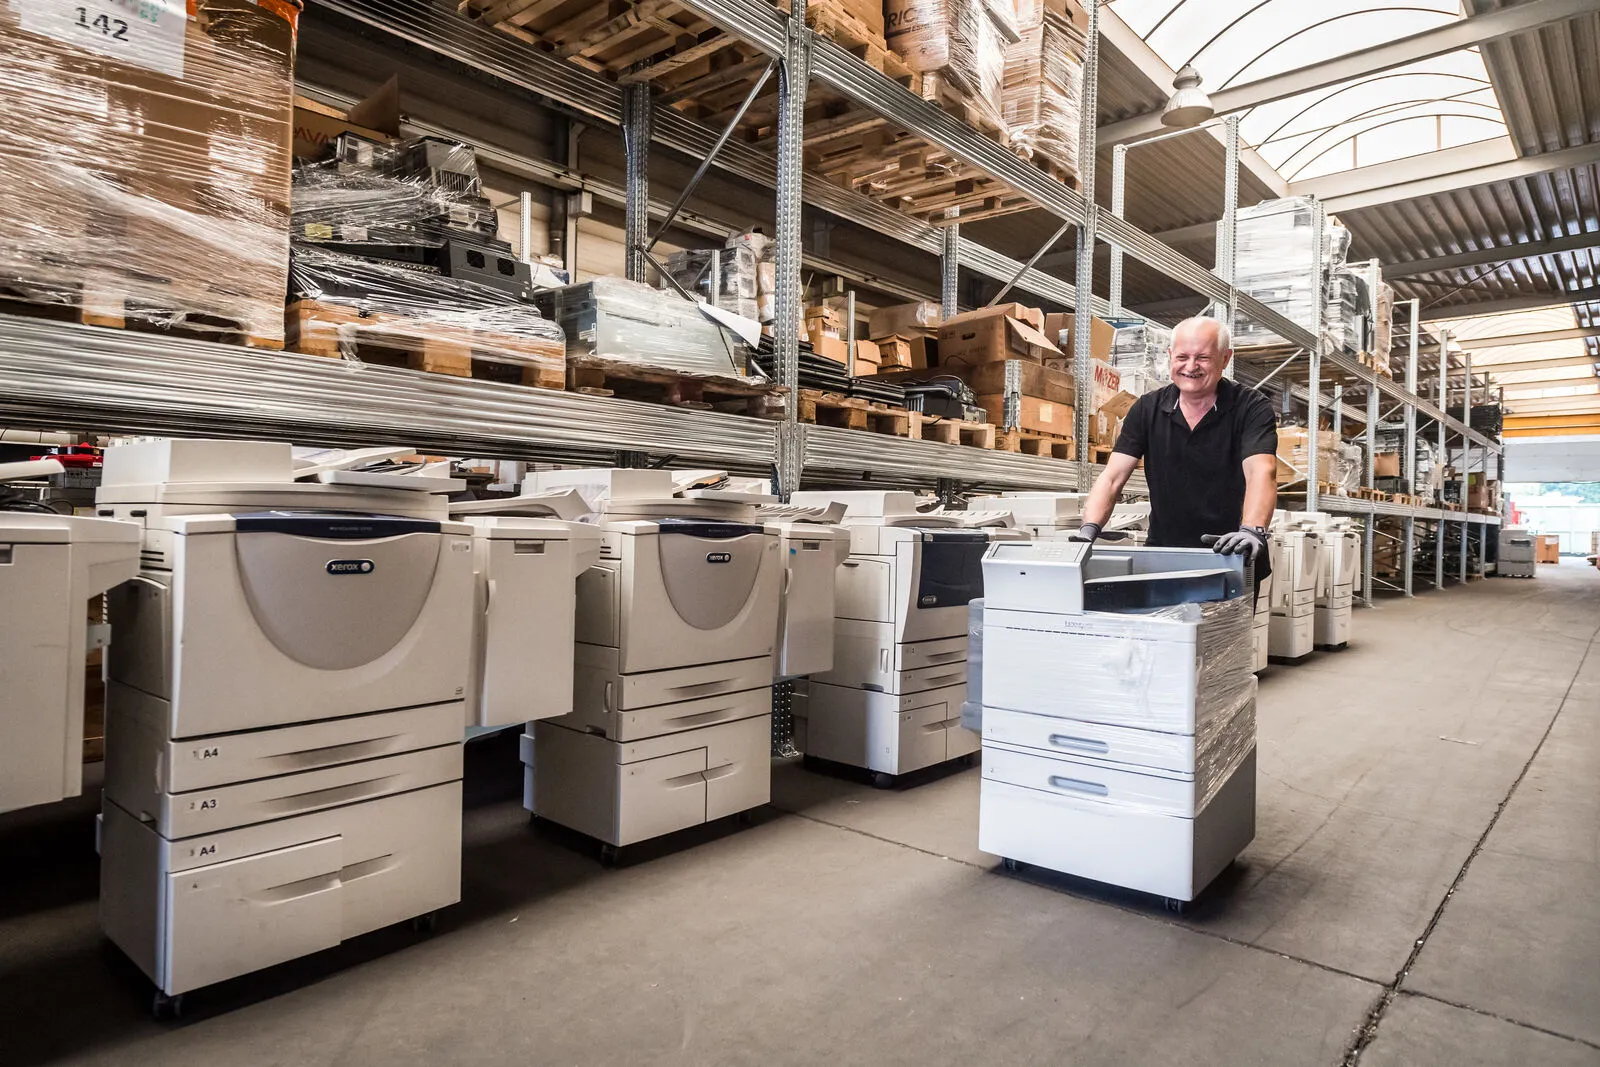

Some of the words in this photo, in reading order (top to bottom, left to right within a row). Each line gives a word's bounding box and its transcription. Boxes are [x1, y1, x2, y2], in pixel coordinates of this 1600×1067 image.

[75, 7, 129, 42] 142
[331, 562, 358, 571] xerox
[203, 747, 219, 759] A4
[201, 799, 217, 811] A3
[200, 844, 216, 857] A4
